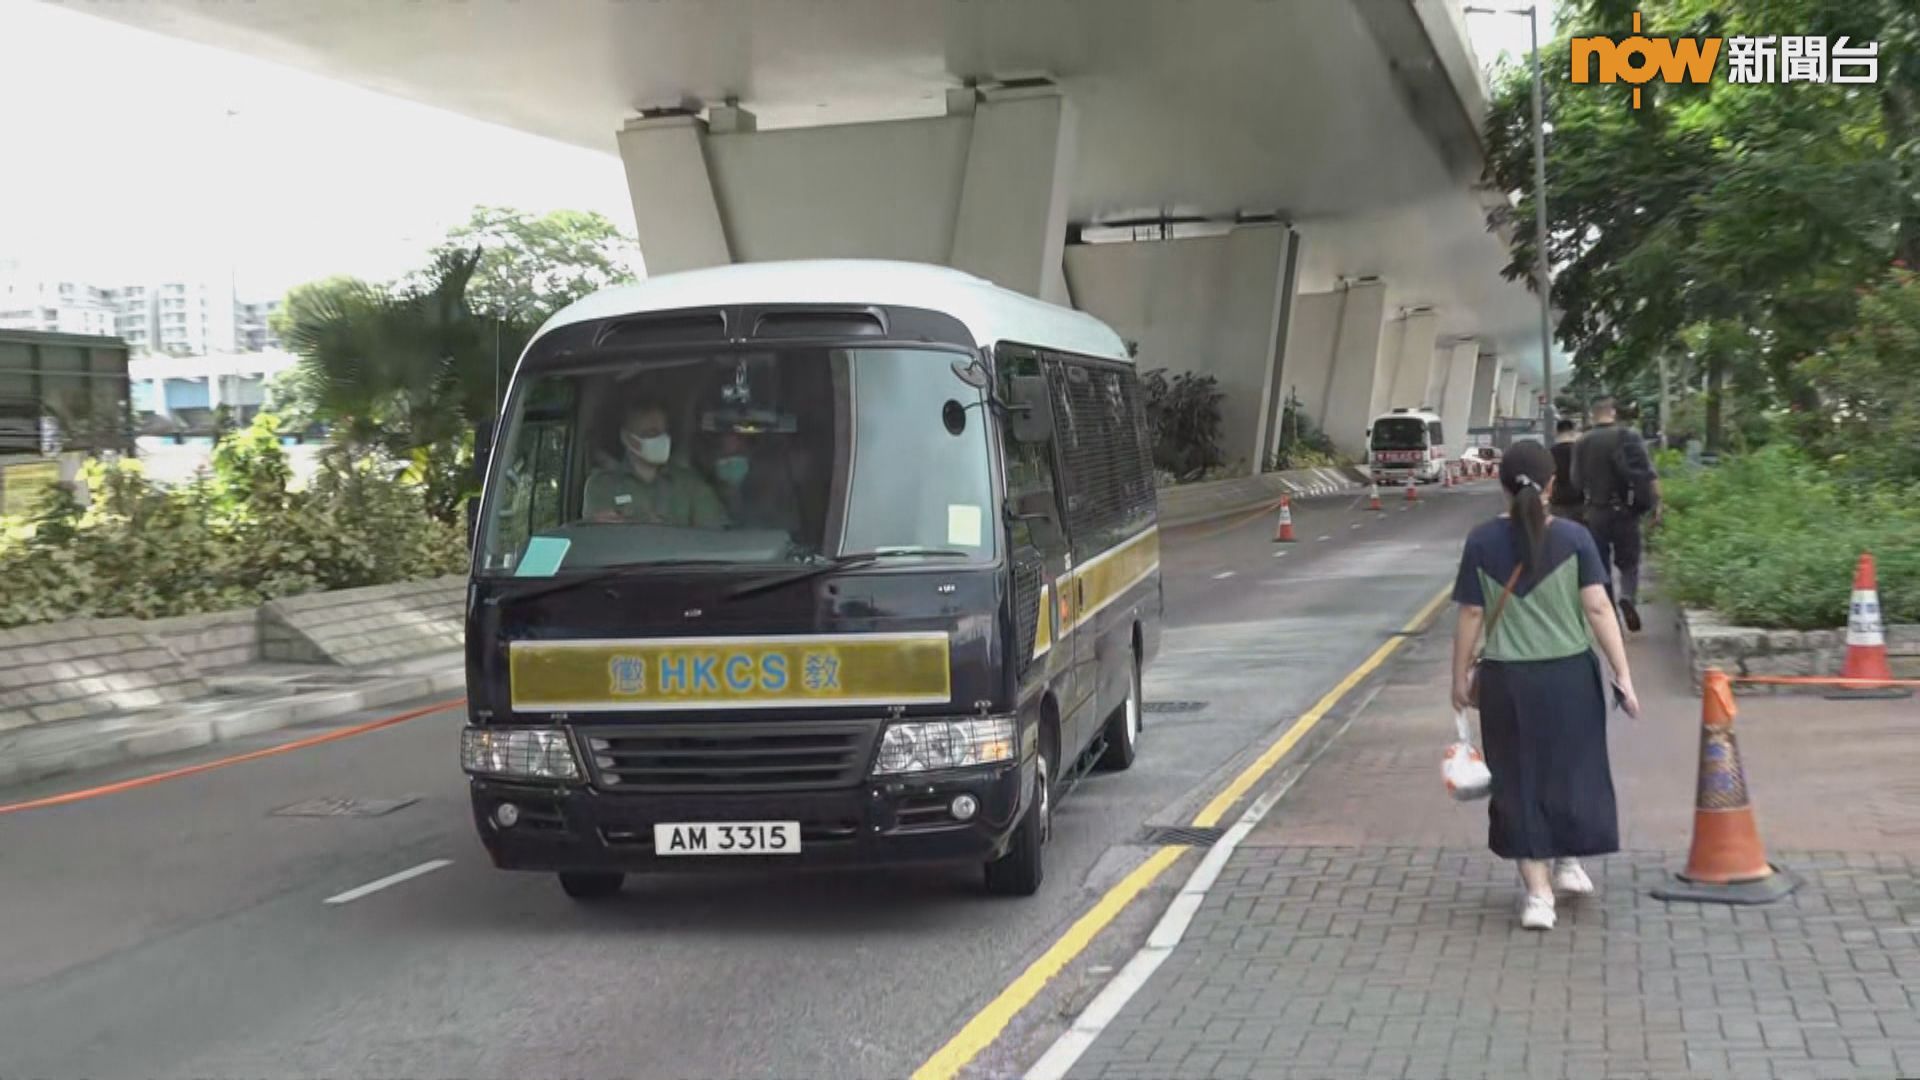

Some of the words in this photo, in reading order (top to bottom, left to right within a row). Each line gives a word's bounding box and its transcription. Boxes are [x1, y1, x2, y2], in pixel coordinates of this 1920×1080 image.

[660, 654, 787, 690] HKCS
[670, 826, 708, 850] AM
[717, 826, 787, 849] 3315
